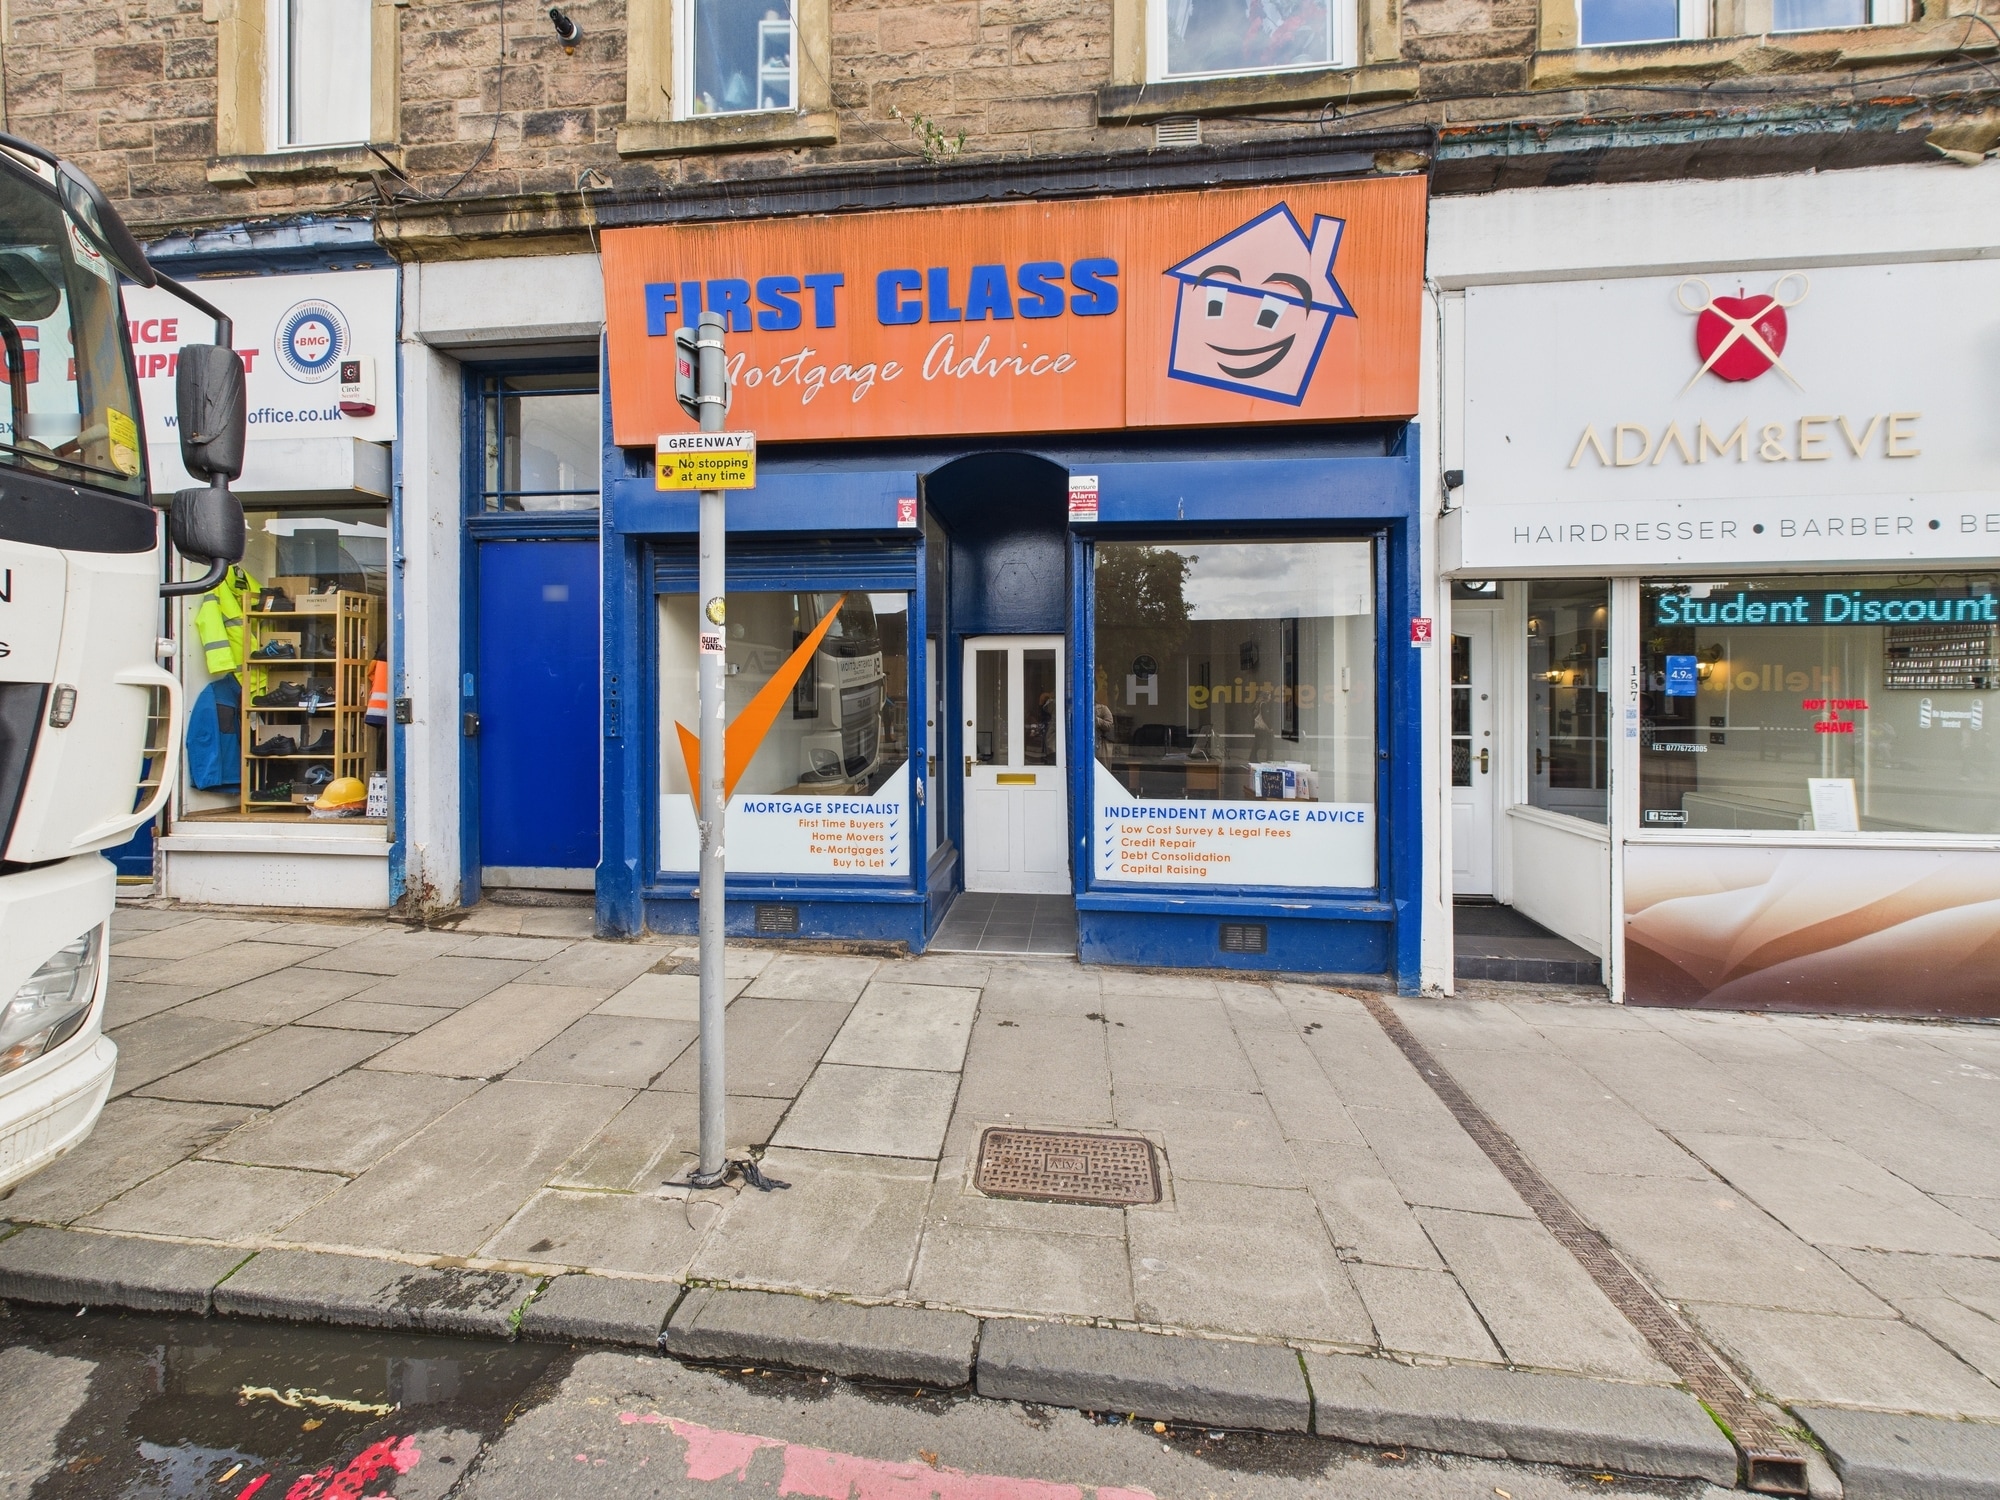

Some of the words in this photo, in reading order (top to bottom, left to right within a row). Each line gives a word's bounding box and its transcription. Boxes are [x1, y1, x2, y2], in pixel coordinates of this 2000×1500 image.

[644, 272, 844, 336] FIRST
[876, 257, 1119, 326] CLASS
[299, 336, 325, 346] BMG
[922, 332, 1077, 381] Advice
[341, 385, 360, 393] Circle
[669, 436, 742, 448] GREENWAY
[1568, 411, 1923, 468] ADAM&EVE
[679, 459, 695, 469] No
[698, 458, 748, 469] stopping
[681, 471, 693, 481] at
[696, 472, 717, 482] any
[720, 470, 746, 480] time
[1514, 521, 1738, 543] HAIRDRESSER
[1780, 516, 1914, 538] BARBER
[1960, 513, 2000, 533] BE
[1658, 592, 1809, 624] Student
[1824, 591, 1998, 622] Discount
[1802, 699, 1826, 710] HOT
[1829, 699, 1870, 710] TOWEL
[1829, 711, 1840, 720] &
[1814, 721, 1855, 733] SHAVE
[743, 802, 822, 813] MORTGAGE
[827, 803, 900, 814] SPECIALIST
[1104, 806, 1206, 819] INDEPENDENT
[1212, 808, 1300, 821] MORTGAGE
[1305, 810, 1365, 823] ADVICE
[799, 819, 819, 828] First
[821, 819, 846, 828] Time
[850, 820, 884, 830] Buyers
[812, 832, 843, 841] Home
[846, 832, 884, 842] Movers
[1121, 825, 1143, 834] Low
[1146, 825, 1172, 834] Cost
[1176, 825, 1213, 837] Survey
[1217, 827, 1225, 836] &
[1229, 827, 1261, 838] Legal
[1265, 828, 1291, 837] Fees
[1121, 837, 1156, 847] Credit
[1160, 838, 1196, 849] Repair
[810, 845, 884, 856] Re-Mortgages
[1121, 851, 1148, 860] Debt
[1152, 851, 1231, 862] Consolidation
[833, 858, 851, 868] Buy
[855, 859, 865, 867] to
[869, 859, 884, 867] Let
[1121, 864, 1162, 875] Capital
[1167, 865, 1207, 877] Raising
